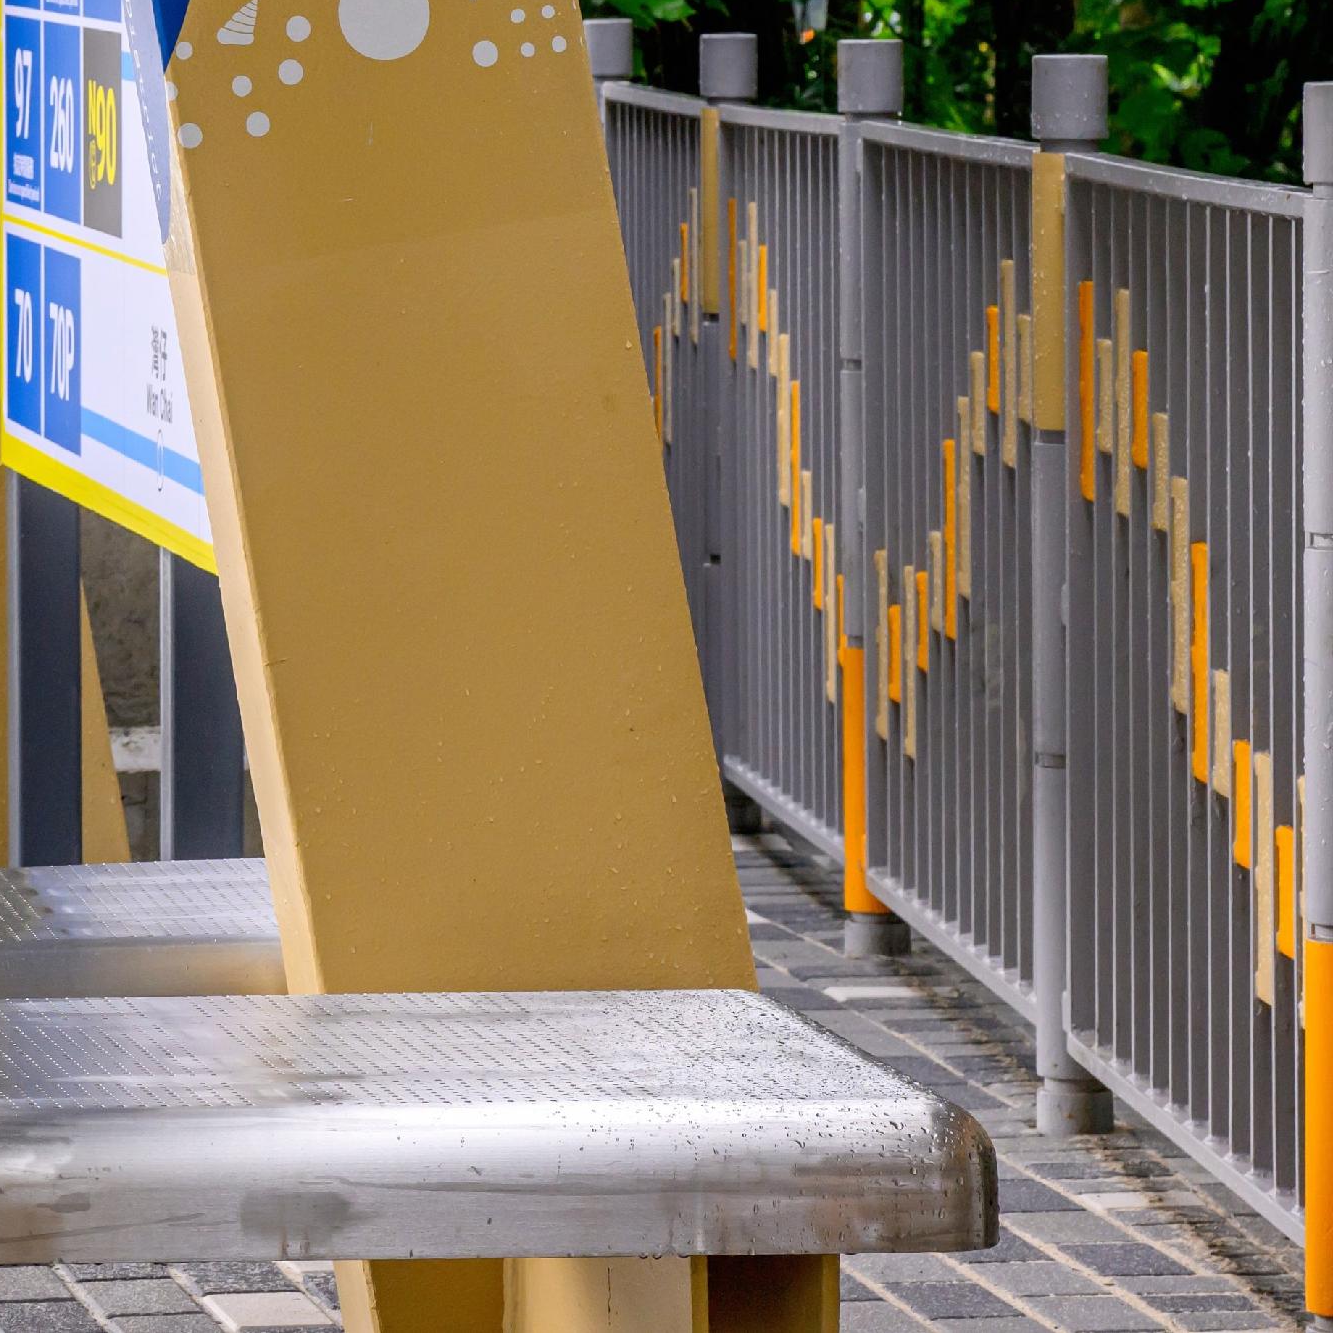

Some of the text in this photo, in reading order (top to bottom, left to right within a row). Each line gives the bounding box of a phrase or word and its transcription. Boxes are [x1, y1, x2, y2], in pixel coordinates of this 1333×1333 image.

[14, 47, 117, 187] 97 260 N90
[14, 288, 75, 402] 70 70P
